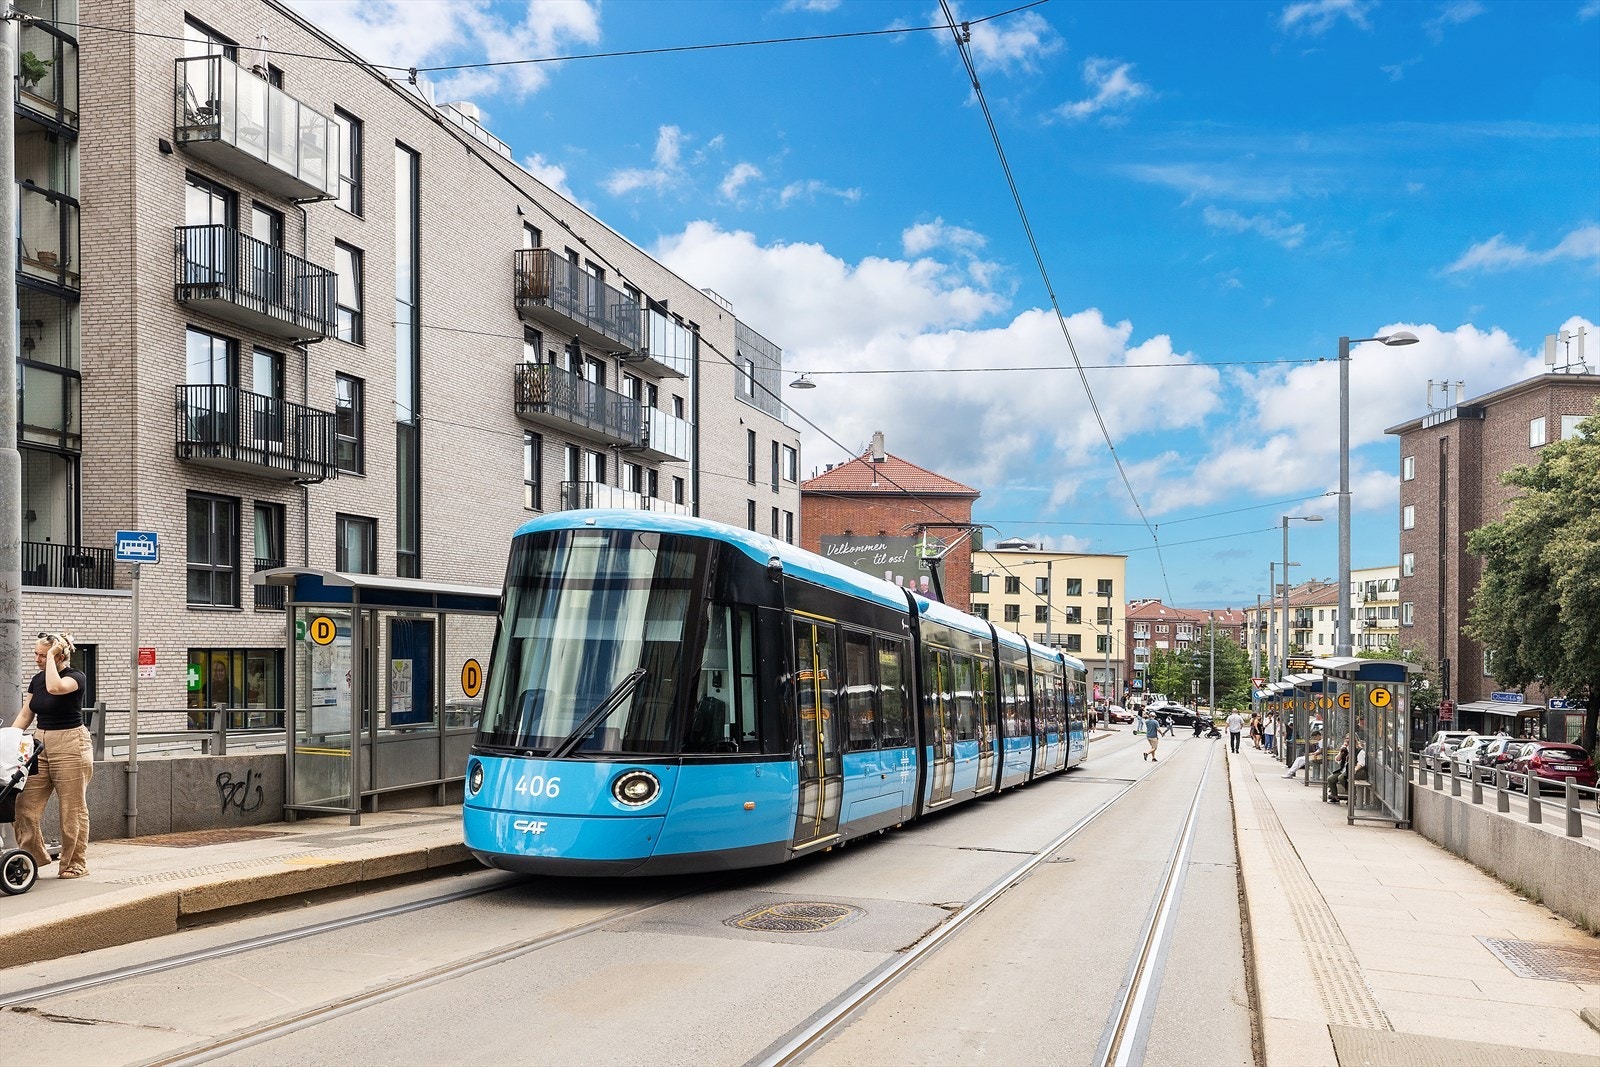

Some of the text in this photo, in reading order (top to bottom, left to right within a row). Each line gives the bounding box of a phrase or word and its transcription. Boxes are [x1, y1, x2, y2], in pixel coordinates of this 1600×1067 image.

[827, 542, 888, 557] Velkommen
[873, 553, 887, 565] til
[888, 550, 909, 564] oss!
[318, 622, 329, 639] D
[468, 667, 476, 684] D
[1343, 696, 1350, 706] F
[1375, 691, 1384, 703] F
[514, 775, 561, 798] 406
[513, 819, 548, 836] CAF
